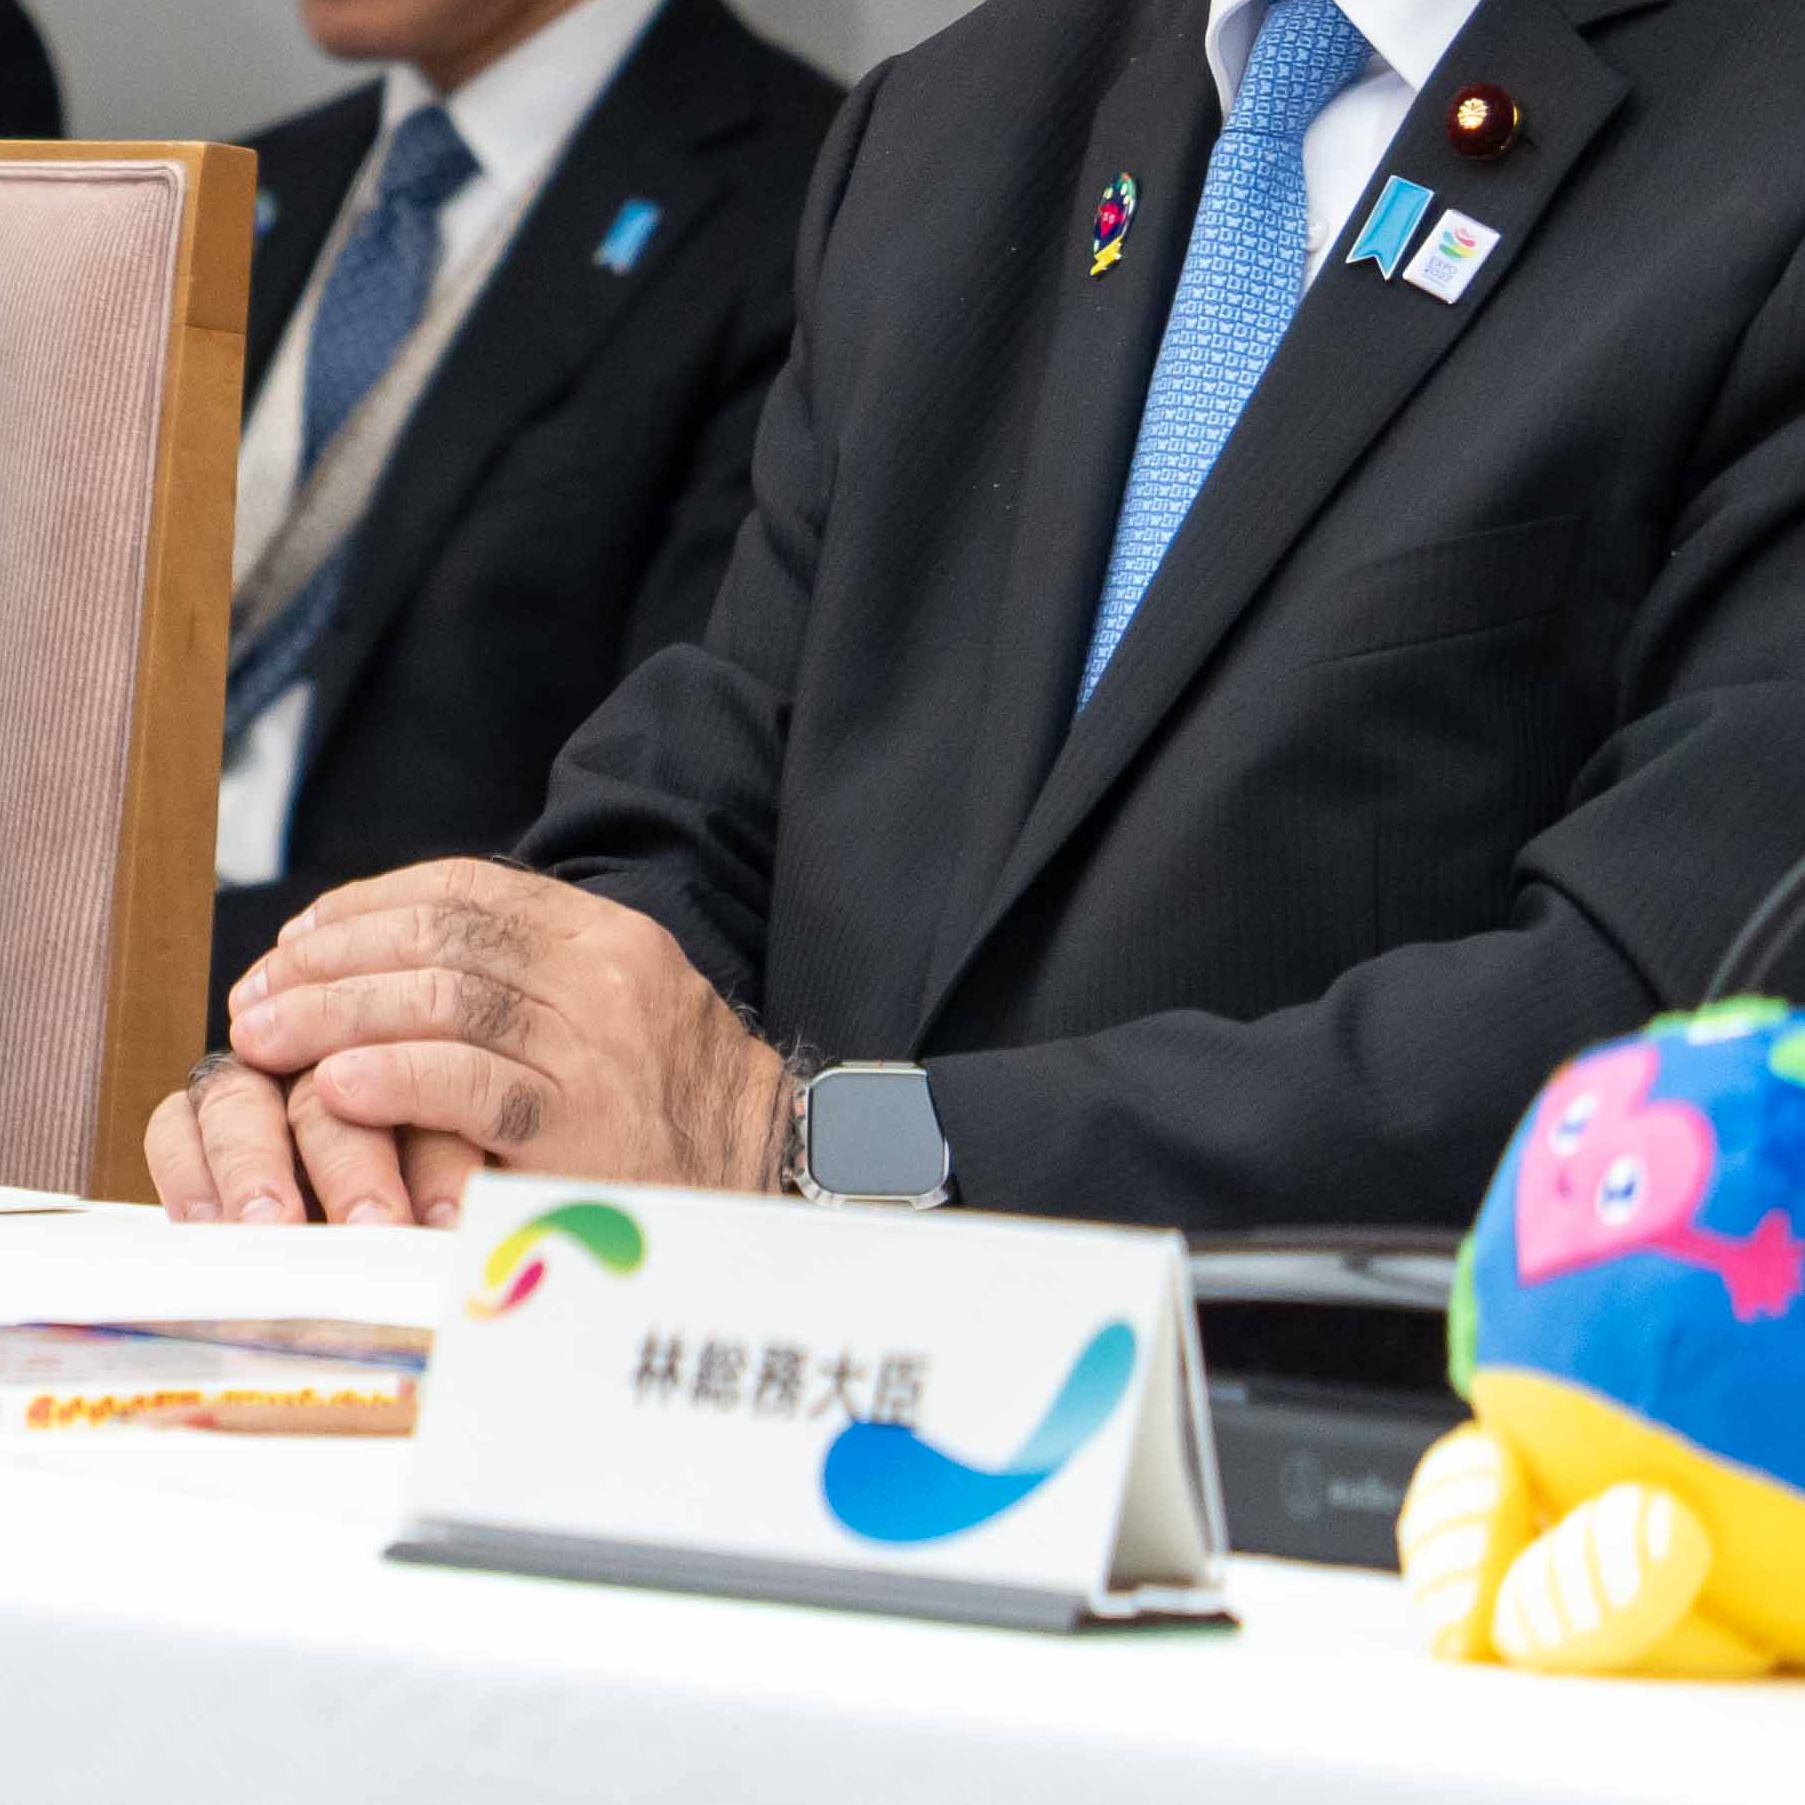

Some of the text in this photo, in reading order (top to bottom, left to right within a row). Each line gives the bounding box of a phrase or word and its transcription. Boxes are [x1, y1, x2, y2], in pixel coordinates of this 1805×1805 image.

[633, 1325, 933, 1429] 林総務大臣
